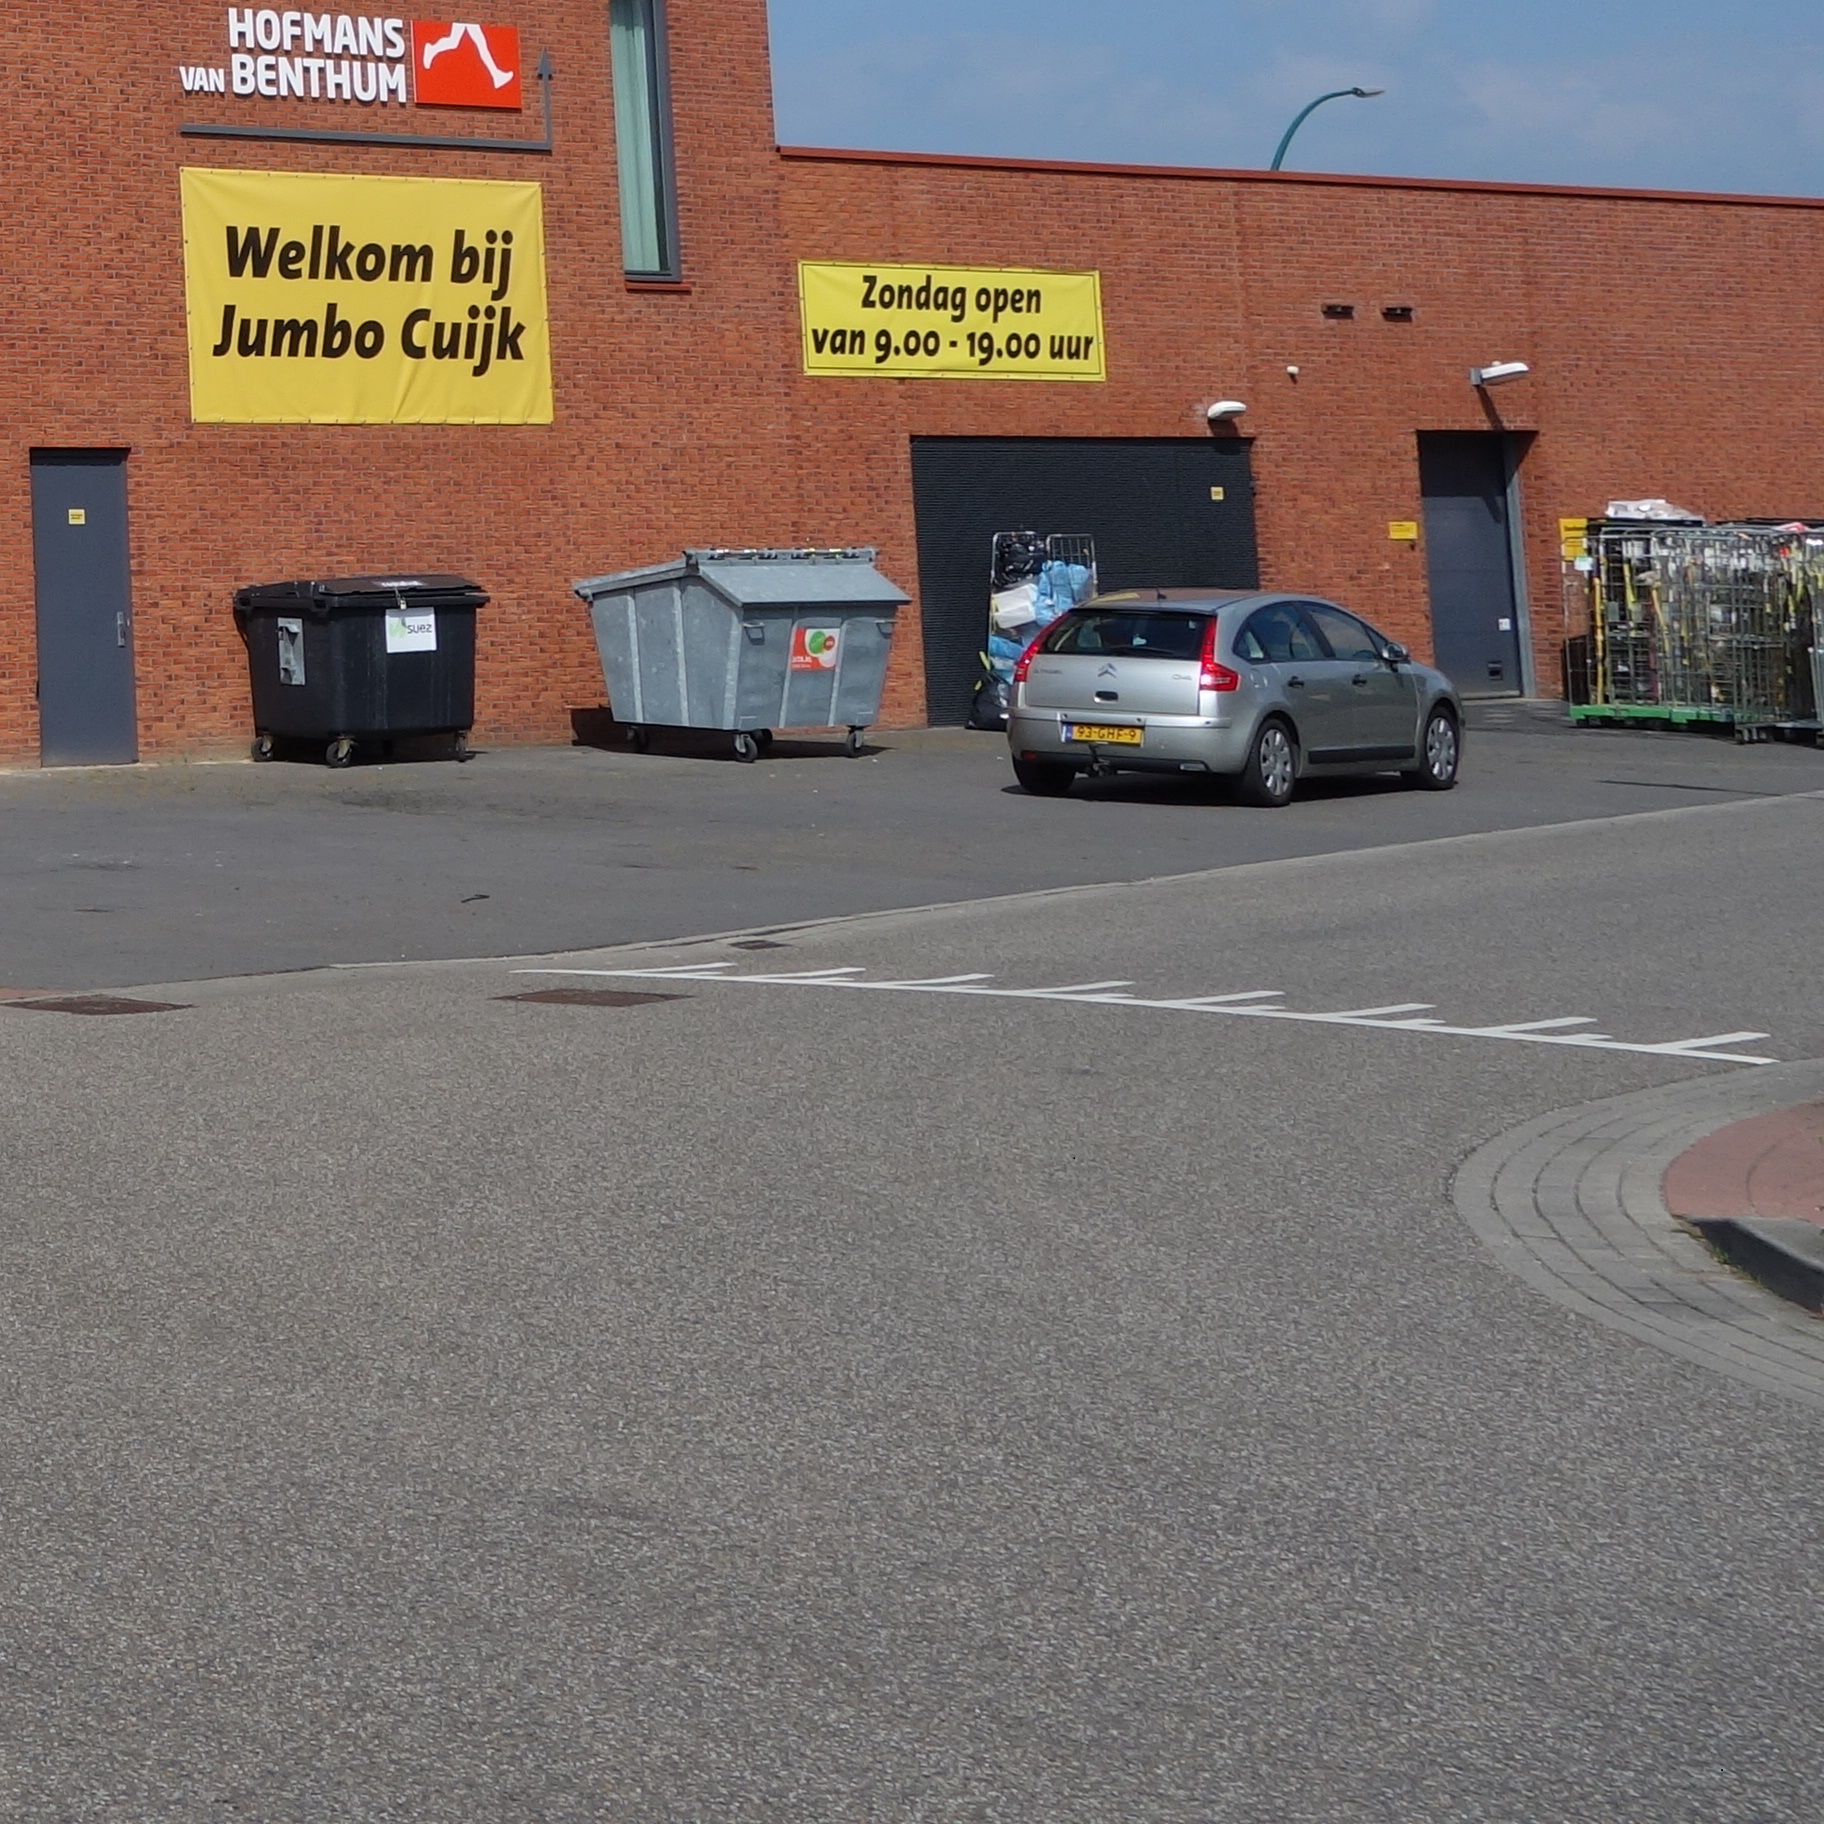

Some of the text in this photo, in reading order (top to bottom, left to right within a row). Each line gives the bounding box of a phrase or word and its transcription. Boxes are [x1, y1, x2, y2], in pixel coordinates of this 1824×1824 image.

[228, 7, 406, 58] HOFMANS
[179, 53, 407, 104] VAN BENTHUM
[225, 224, 513, 302] Welkom bij
[861, 274, 1041, 324] Zondag open
[212, 302, 527, 378] Jumbo Cuijk
[811, 327, 865, 356] van
[874, 328, 941, 364] 9.00
[966, 331, 1041, 367] 19.00
[1049, 334, 1094, 361] uur
[407, 623, 433, 635] suez
[1076, 725, 1137, 741] 93-GHF-9
